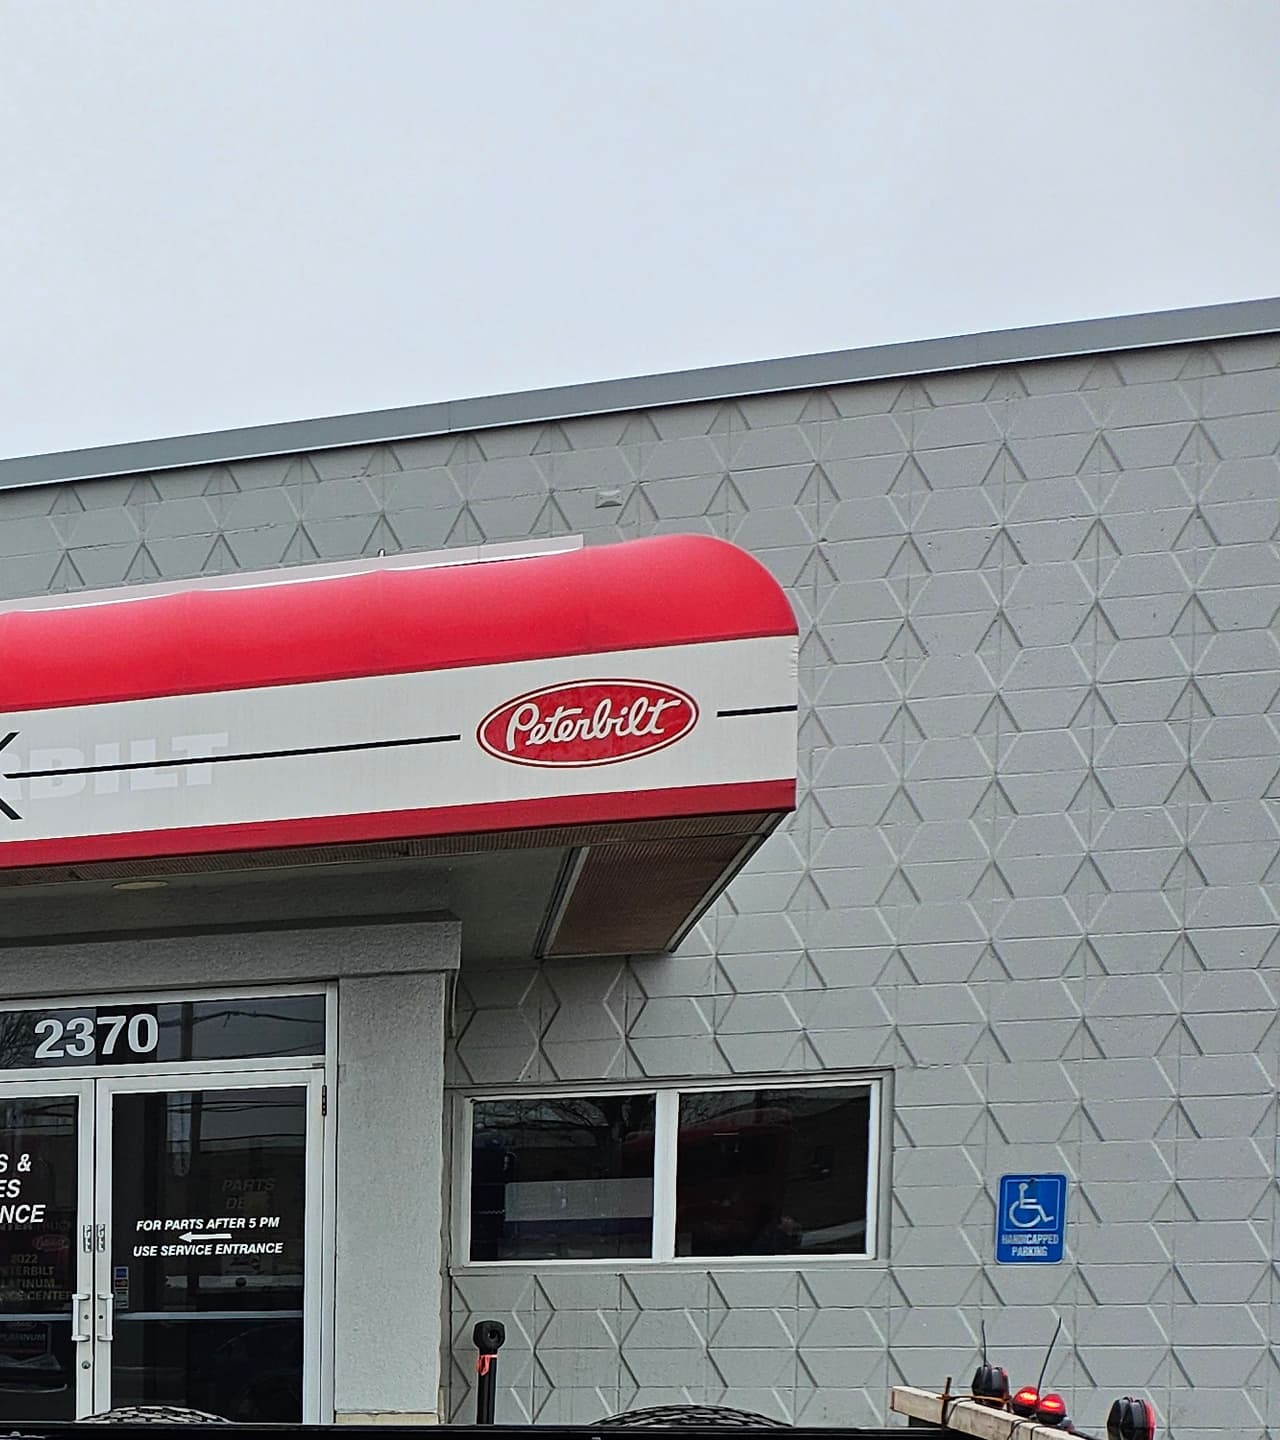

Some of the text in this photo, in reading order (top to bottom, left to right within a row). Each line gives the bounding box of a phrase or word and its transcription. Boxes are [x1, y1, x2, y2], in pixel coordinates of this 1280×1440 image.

[505, 696, 681, 751] Peterbilt
[34, 1013, 159, 1060] 2370
[17, 1153, 32, 1173] &
[136, 1217, 280, 1232] FOR PARTS AFTER 5 PM
[133, 1243, 283, 1257] USE SERVICE ENTRANCE
[1011, 1246, 1048, 1256] PARKING
